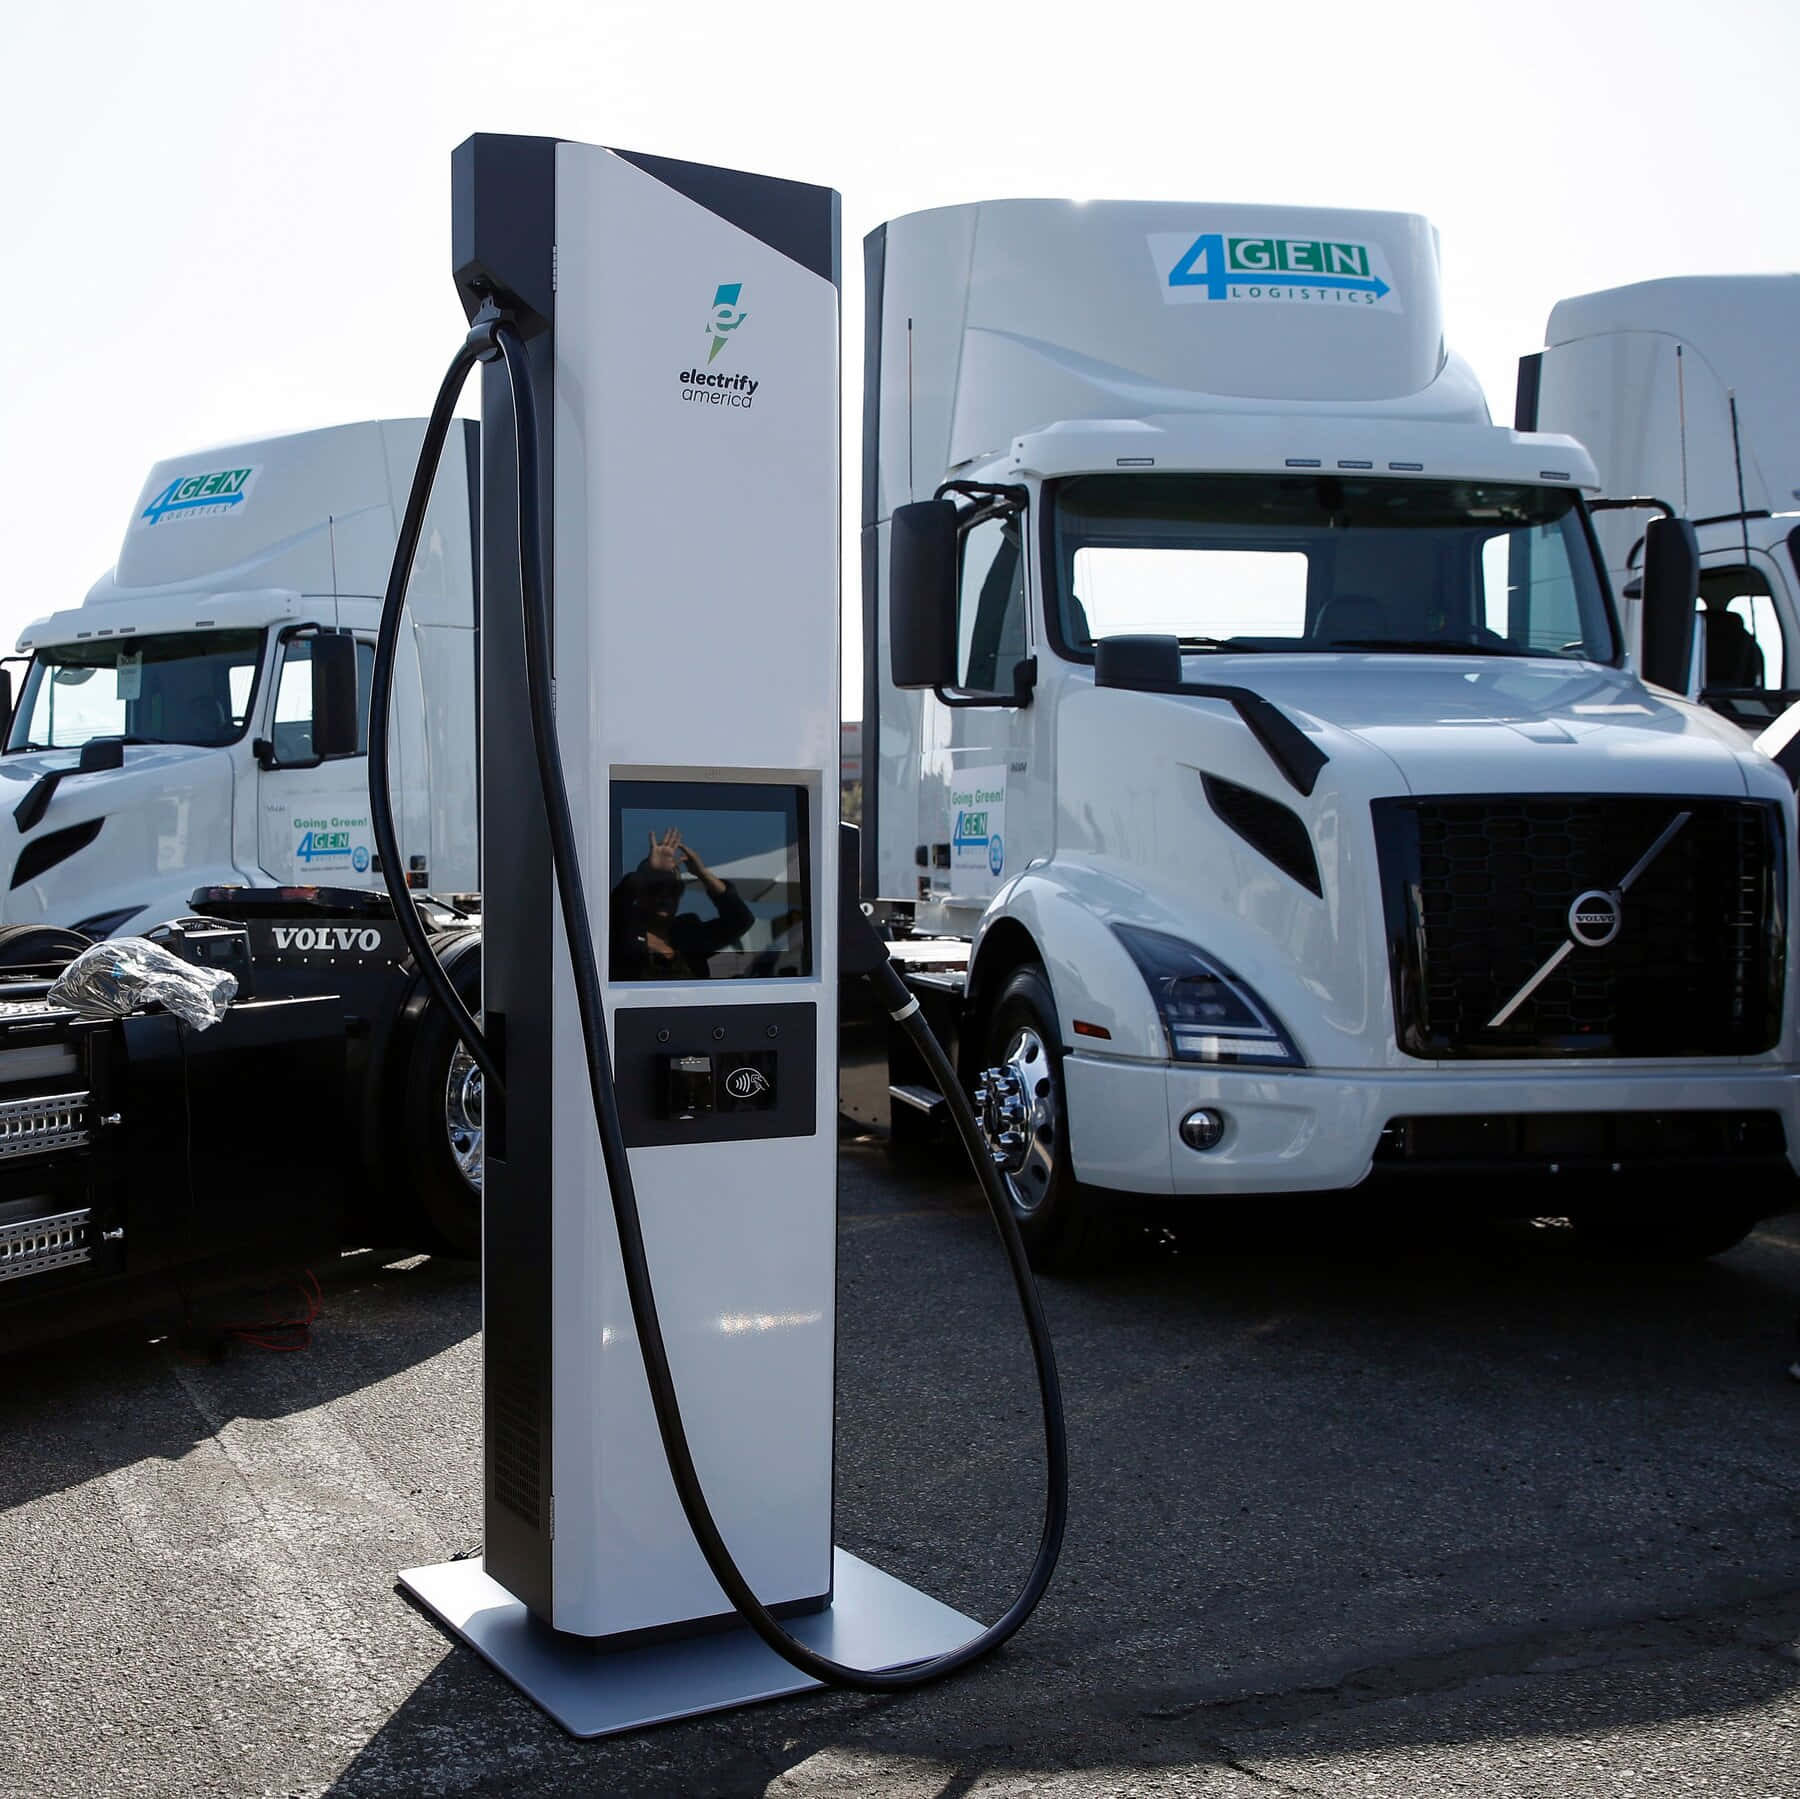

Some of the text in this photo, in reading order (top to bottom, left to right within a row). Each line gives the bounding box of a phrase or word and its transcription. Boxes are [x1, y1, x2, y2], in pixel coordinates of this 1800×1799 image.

[1232, 287, 1374, 304] LOGISTICS
[680, 368, 759, 395] electrify
[682, 388, 752, 408] america
[952, 787, 1004, 807] Going Green!
[294, 818, 368, 830] Going Green!
[271, 927, 381, 952] VOLVO
